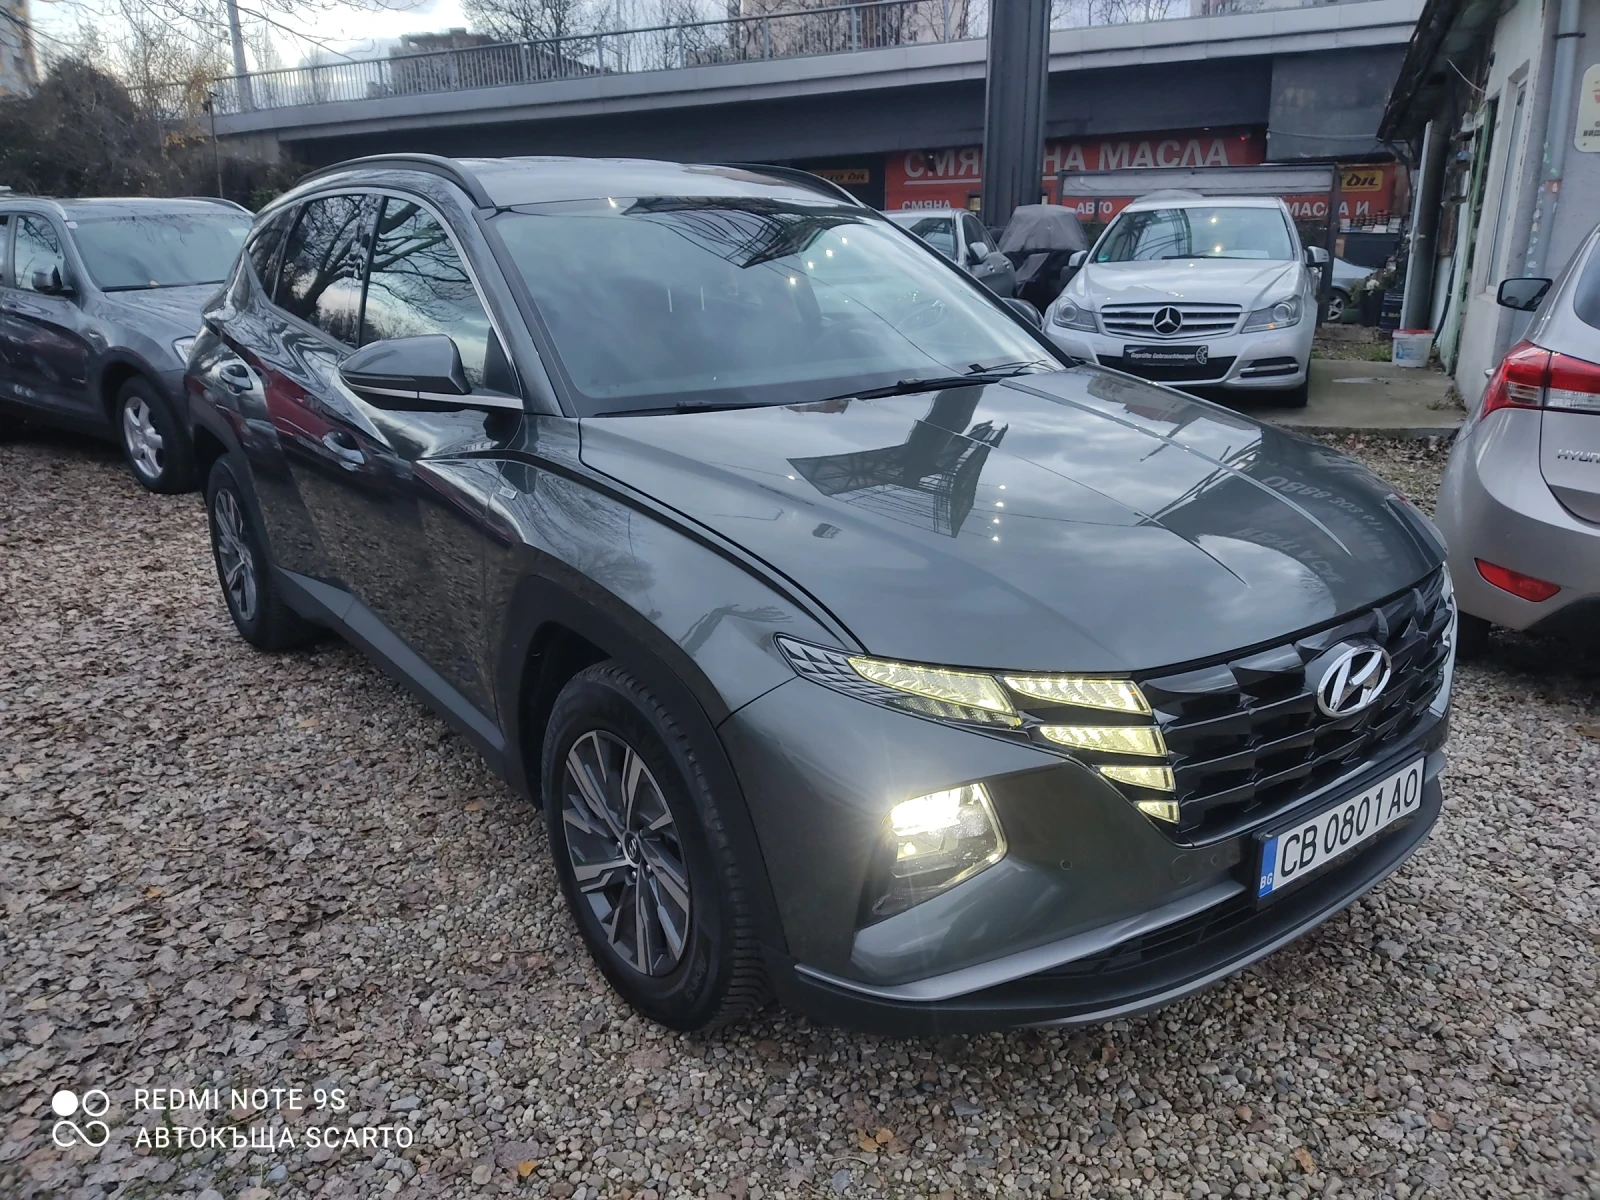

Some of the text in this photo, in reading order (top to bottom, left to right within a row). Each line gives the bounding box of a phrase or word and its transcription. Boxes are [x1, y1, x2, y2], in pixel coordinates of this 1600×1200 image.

[1100, 138, 1230, 170] МАСЛА
[901, 200, 951, 210] СМЯНА
[1355, 201, 1369, 216] И
[1280, 768, 1418, 878] CB 0801 AO
[1260, 872, 1273, 890] BG
